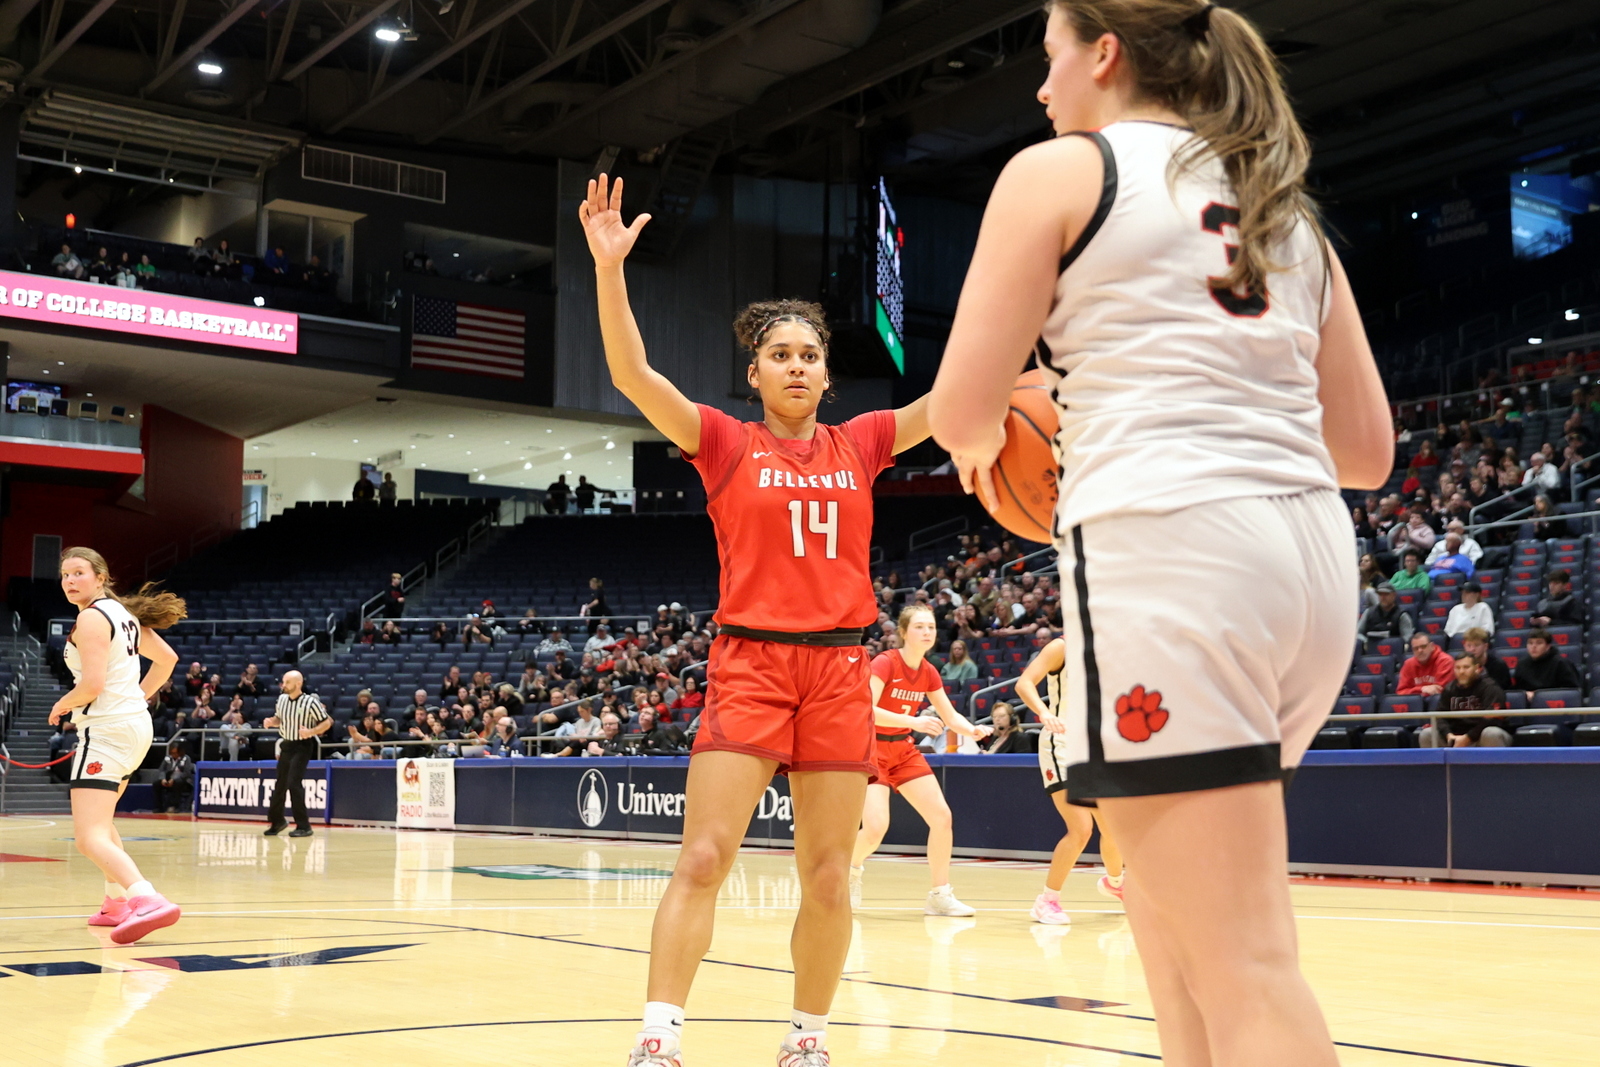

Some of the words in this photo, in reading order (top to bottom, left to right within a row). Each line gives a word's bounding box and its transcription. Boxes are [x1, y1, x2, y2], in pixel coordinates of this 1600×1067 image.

[1200, 201, 1270, 319] 3
[12, 288, 44, 309] OF
[46, 293, 147, 323] COLLEGE
[758, 467, 858, 491] BELLEVUE
[787, 499, 839, 560] 14
[121, 620, 140, 656] 32
[200, 777, 261, 807] DAYTON
[617, 783, 686, 817] Univer
[400, 805, 423, 818] RADIO
